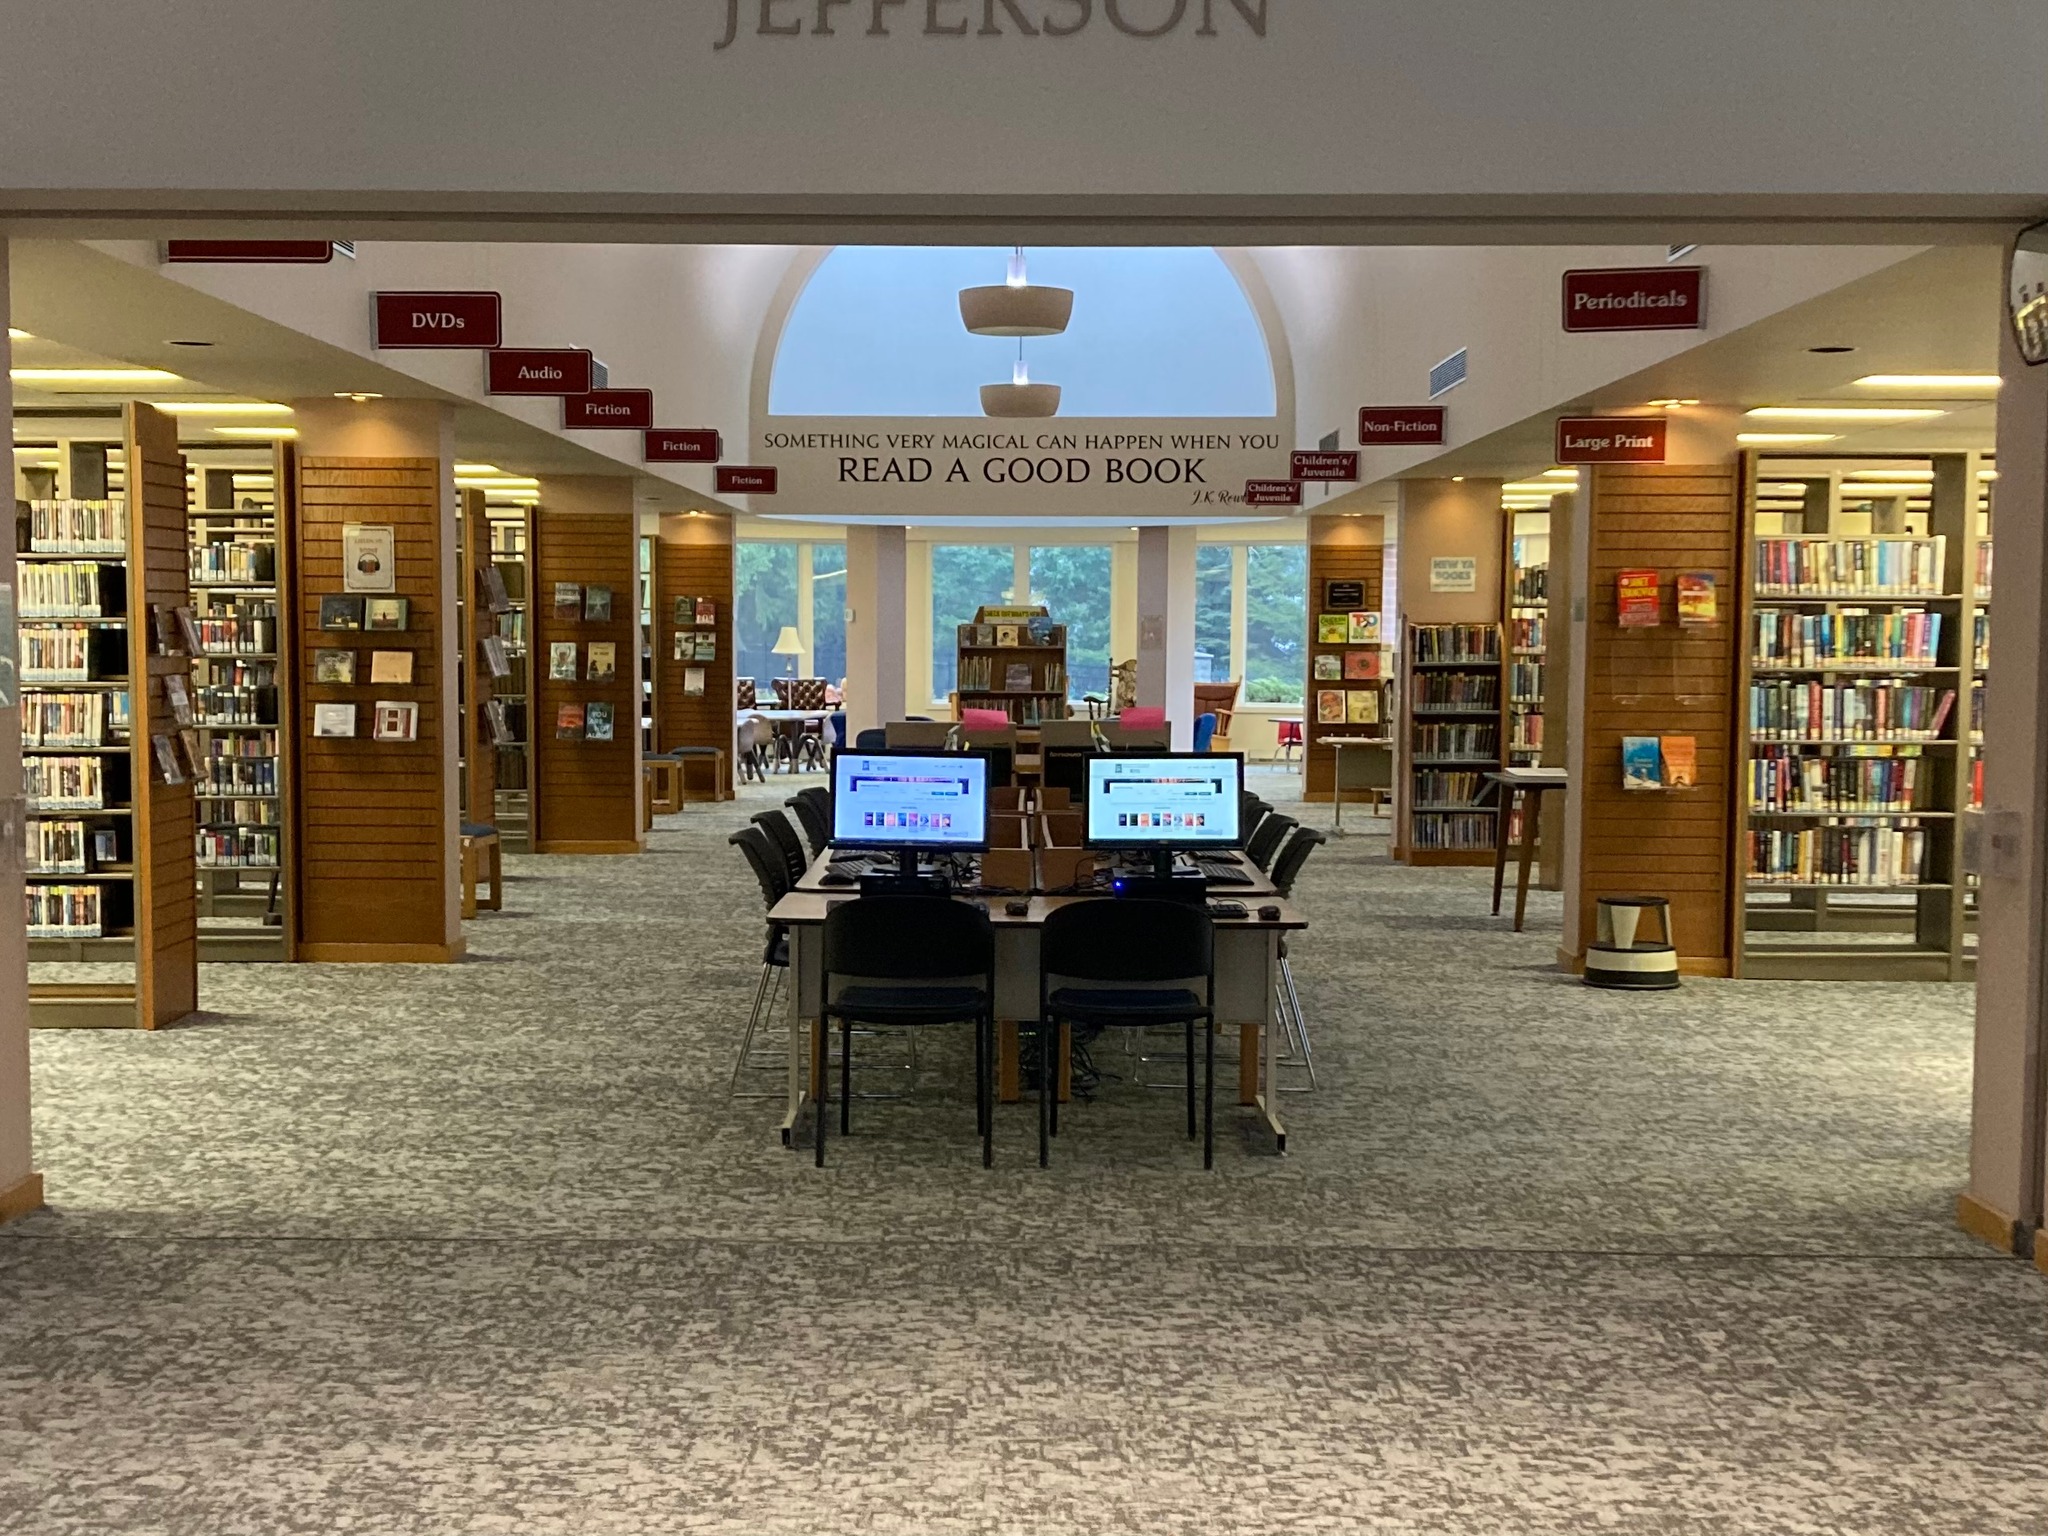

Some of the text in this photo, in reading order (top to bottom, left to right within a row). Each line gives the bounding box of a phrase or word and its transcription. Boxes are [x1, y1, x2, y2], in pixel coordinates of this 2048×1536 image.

[1574, 289, 1688, 310] Periodicals
[412, 312, 465, 329] DVDs
[517, 365, 563, 379] Audio
[585, 403, 631, 416] Fiction
[1361, 418, 1438, 434] Non-Fiction
[663, 440, 701, 453] Fiction
[765, 434, 1279, 449] SOMETHING VERY MAGICAL CAN HAPPEN WHEN YOU
[1565, 433, 1655, 453] Large Print
[839, 458, 1208, 484] READ A GOOD BOOK
[1301, 467, 1346, 478] Juvenile
[731, 474, 764, 486] Fiction
[1253, 493, 1292, 502] Juvenile
